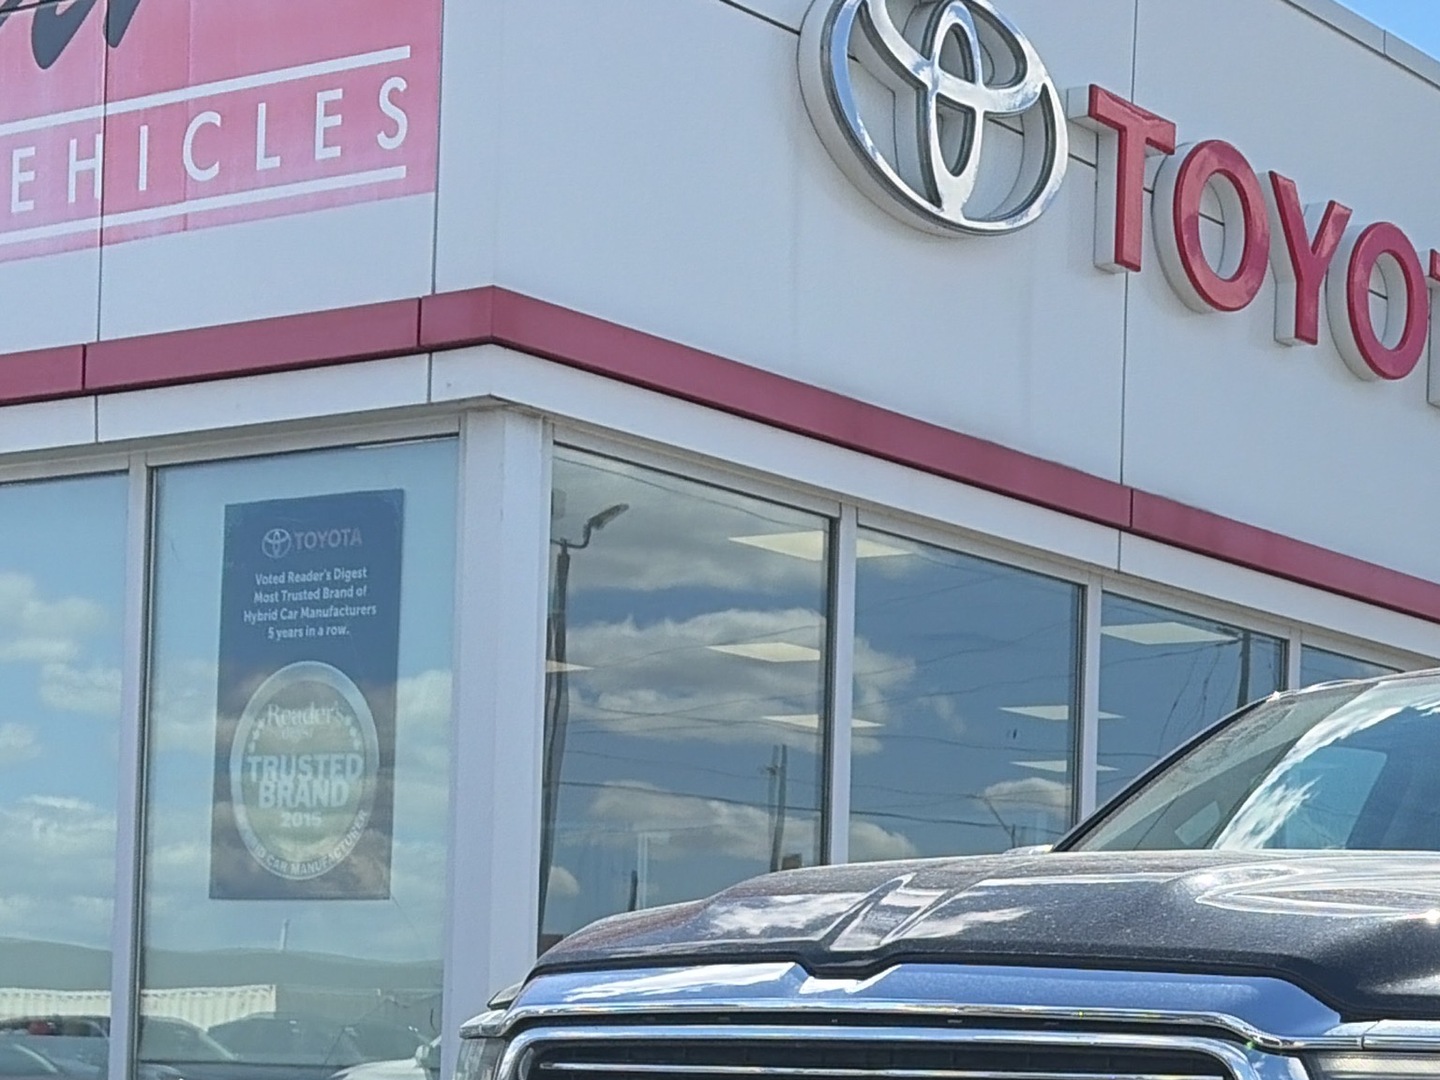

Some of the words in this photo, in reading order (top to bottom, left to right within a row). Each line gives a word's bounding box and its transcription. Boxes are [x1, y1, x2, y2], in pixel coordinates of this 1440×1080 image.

[10, 76, 410, 214] EHICLES
[294, 528, 362, 549] TOYOTA
[255, 572, 286, 585] Voted
[287, 568, 331, 583] Reader's
[333, 566, 367, 582] Digest
[254, 591, 279, 603] Most
[281, 587, 320, 602] Trusted
[322, 586, 354, 600] Brand
[355, 584, 367, 597] of
[243, 608, 279, 625] Hybrid
[280, 607, 299, 621] Car
[300, 604, 377, 619] Manufacturers
[267, 626, 275, 640] 5
[275, 627, 304, 641] years
[305, 625, 316, 637] in
[317, 626, 325, 637] a
[325, 625, 350, 637] row.
[267, 702, 345, 728] Reader's
[247, 754, 365, 784] TRUSTED
[258, 779, 350, 808] BRAND
[265, 854, 288, 873] CAR
[290, 808, 368, 876] MANUFACTURER
